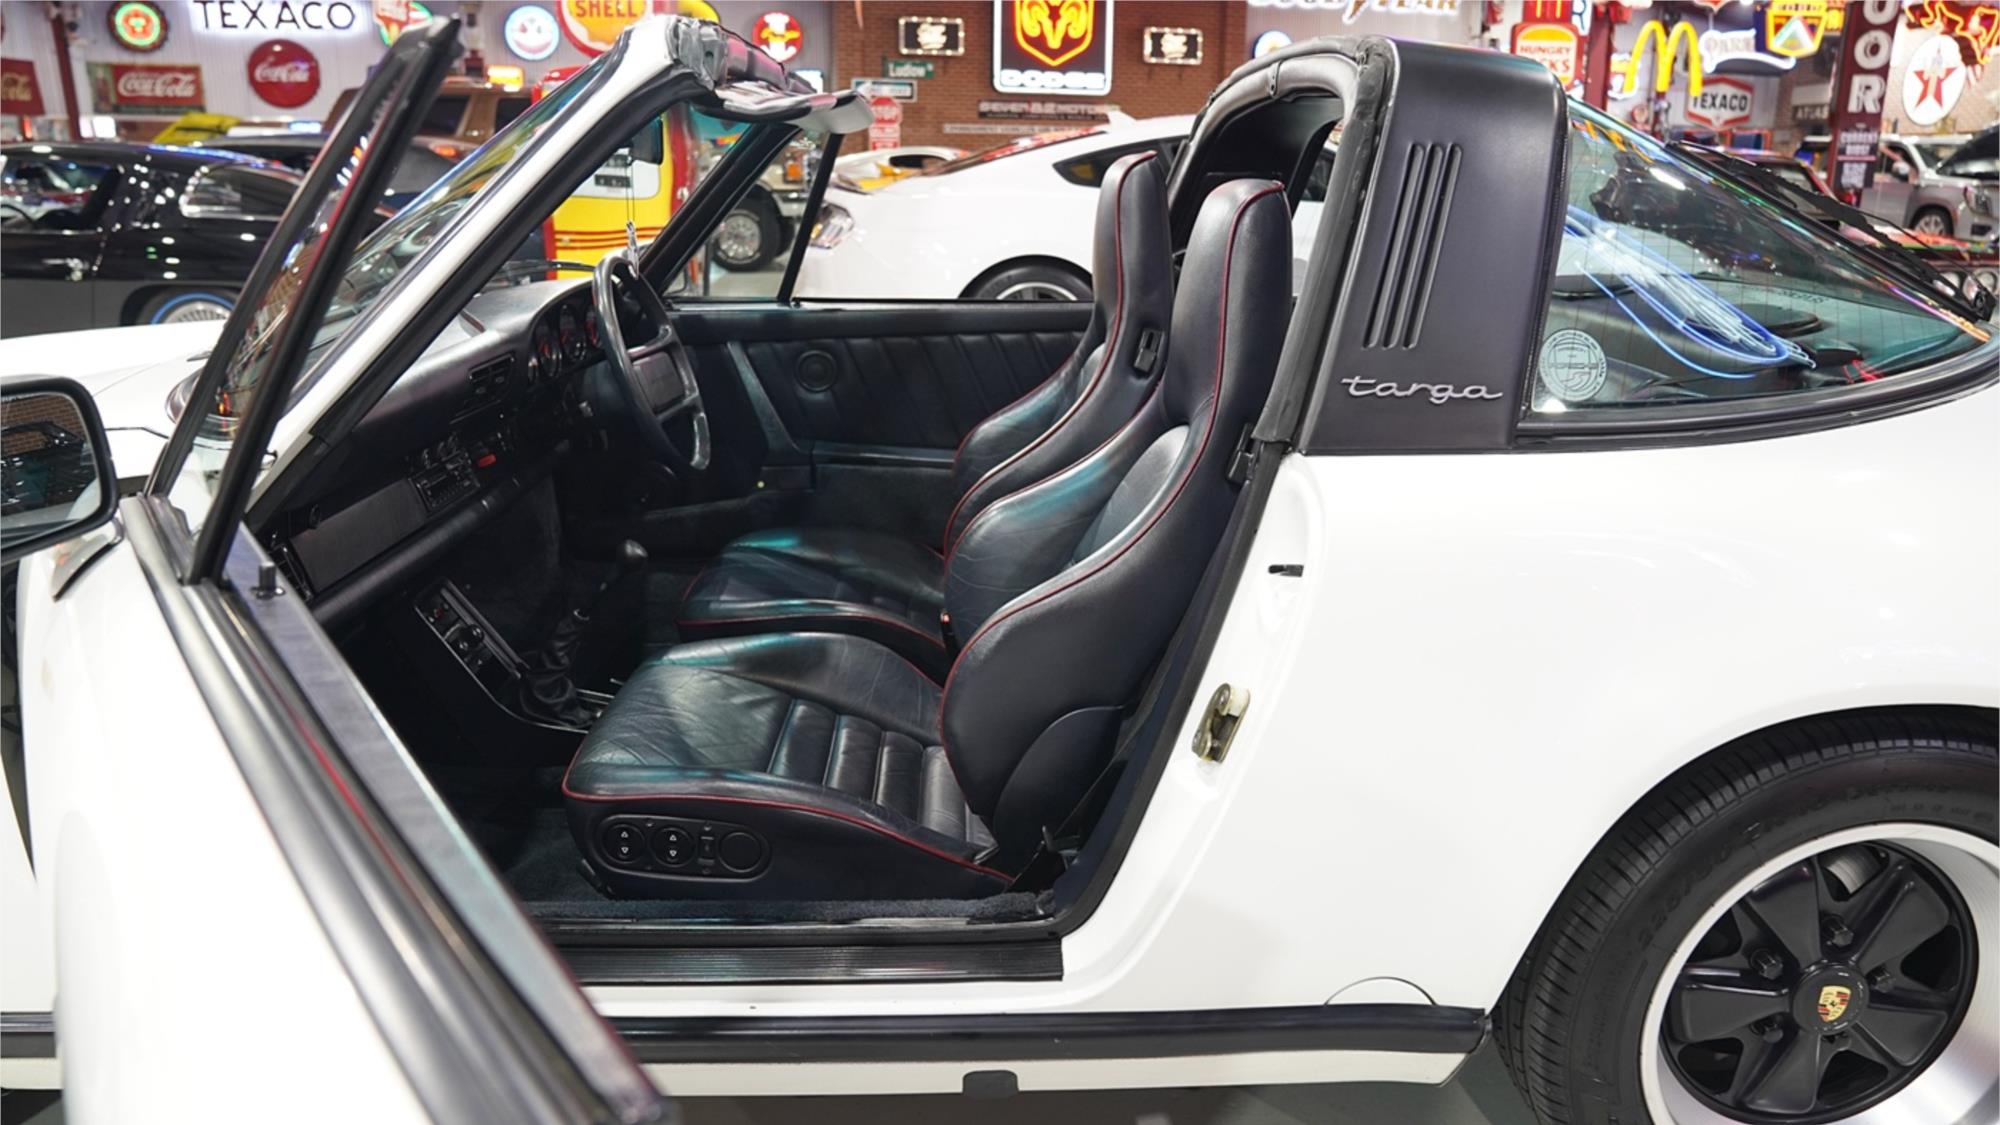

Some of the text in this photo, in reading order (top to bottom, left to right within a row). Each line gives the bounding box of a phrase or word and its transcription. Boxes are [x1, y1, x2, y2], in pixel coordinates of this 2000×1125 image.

[193, 1, 355, 29] TEXACO
[576, 0, 637, 17] SHELL
[117, 71, 196, 98] Coca-Cola
[1341, 375, 1503, 404] targa
